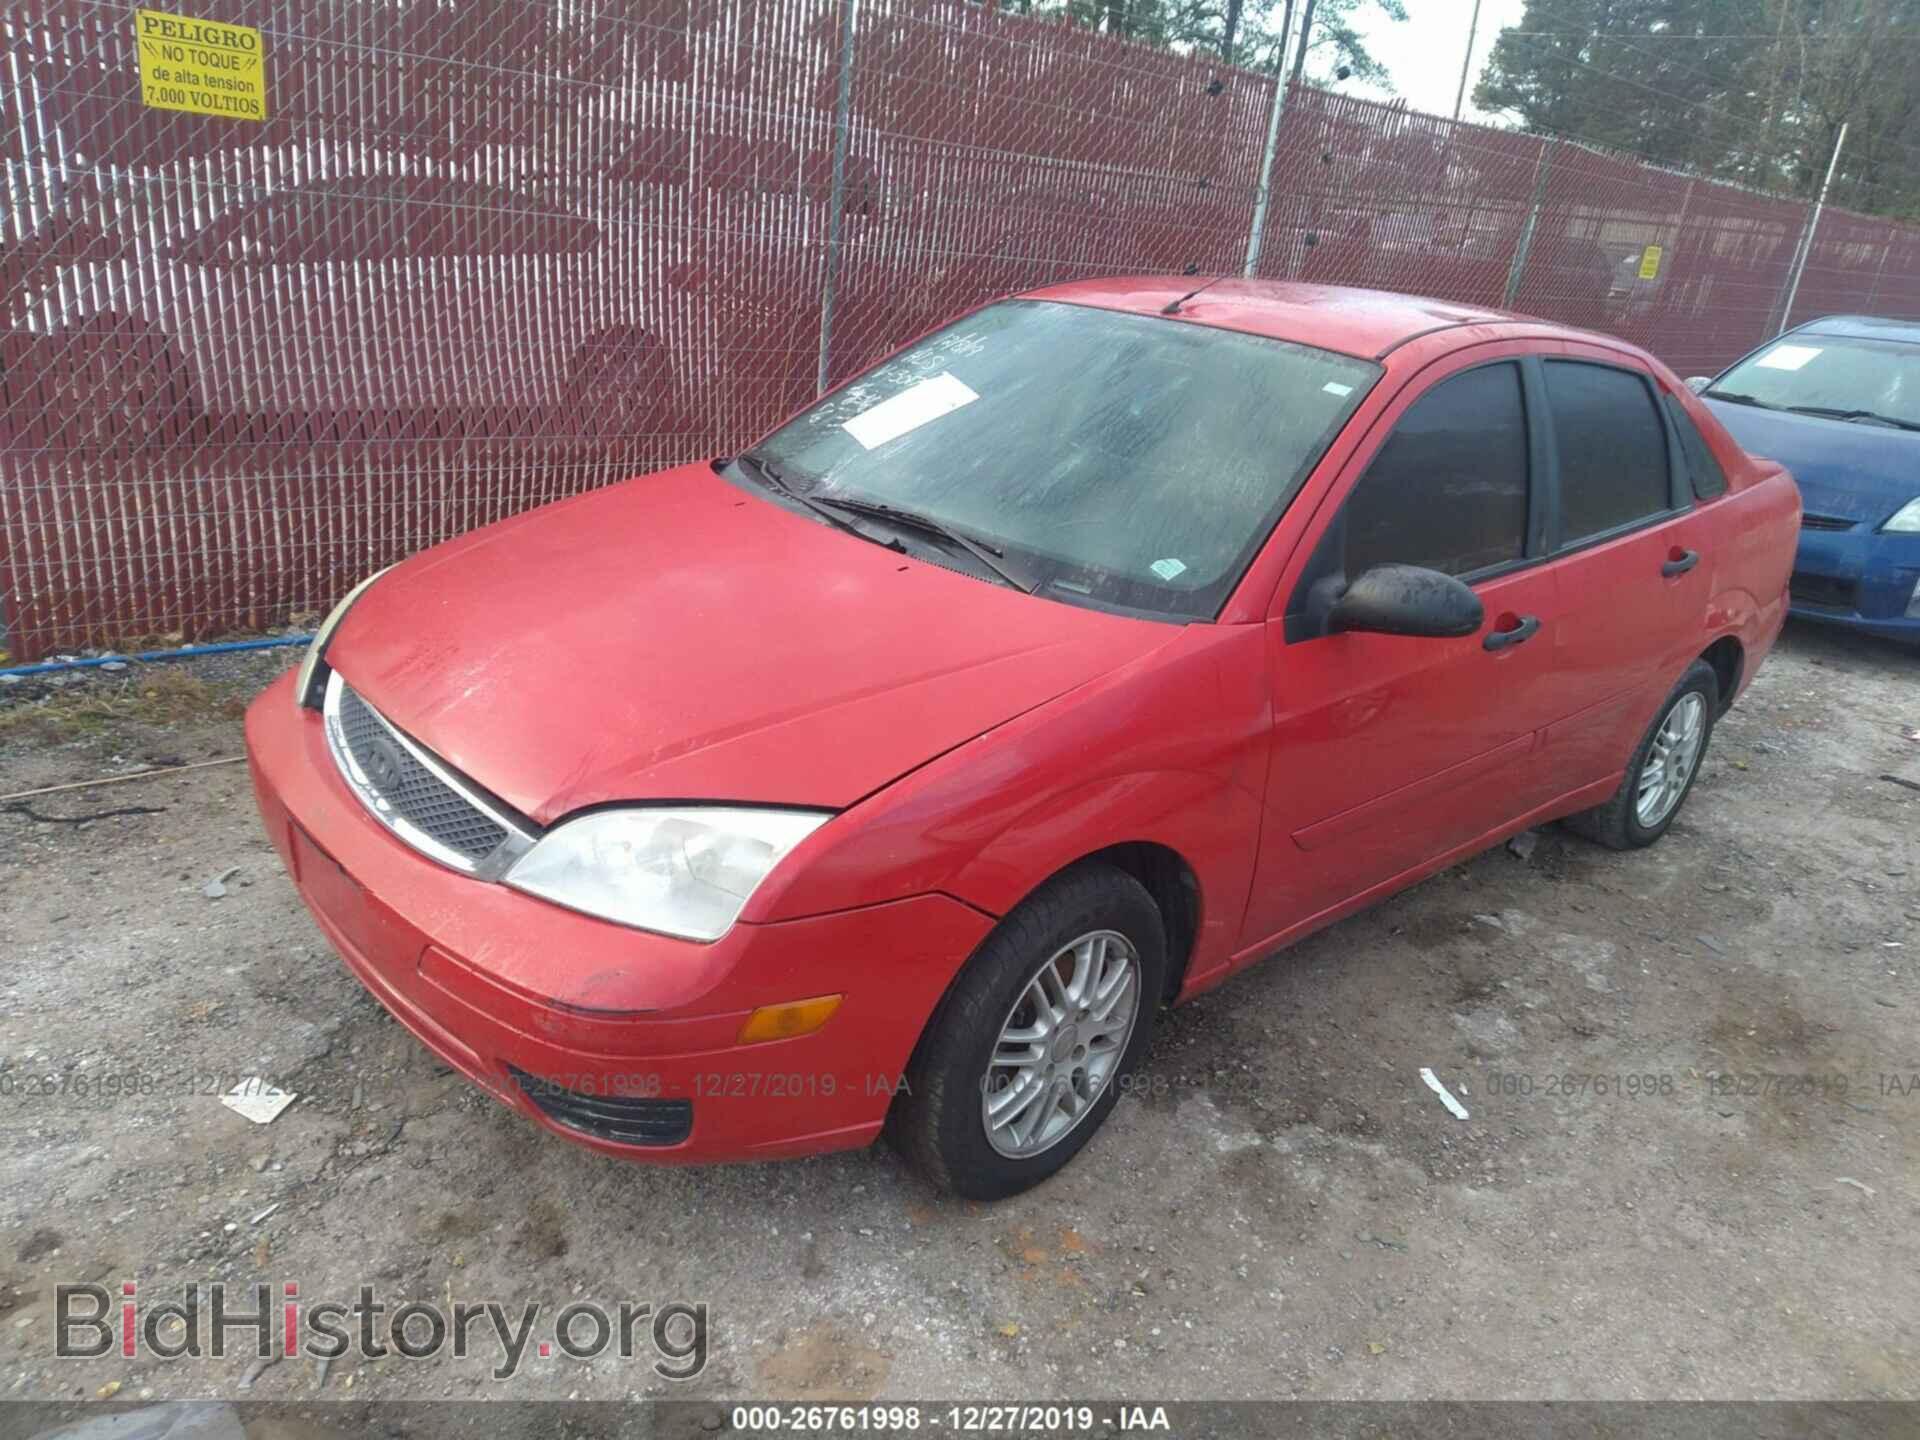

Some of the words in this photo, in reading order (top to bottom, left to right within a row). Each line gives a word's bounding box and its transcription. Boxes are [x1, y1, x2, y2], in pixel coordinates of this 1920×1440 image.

[143, 16, 256, 50] PELIGRO
[162, 45, 184, 62] NO
[189, 49, 241, 71] TOQUE
[152, 65, 170, 80] de
[174, 68, 200, 85] alta
[204, 72, 255, 93] tension
[146, 86, 185, 104] 7,000
[190, 91, 260, 114] VOLTIOS
